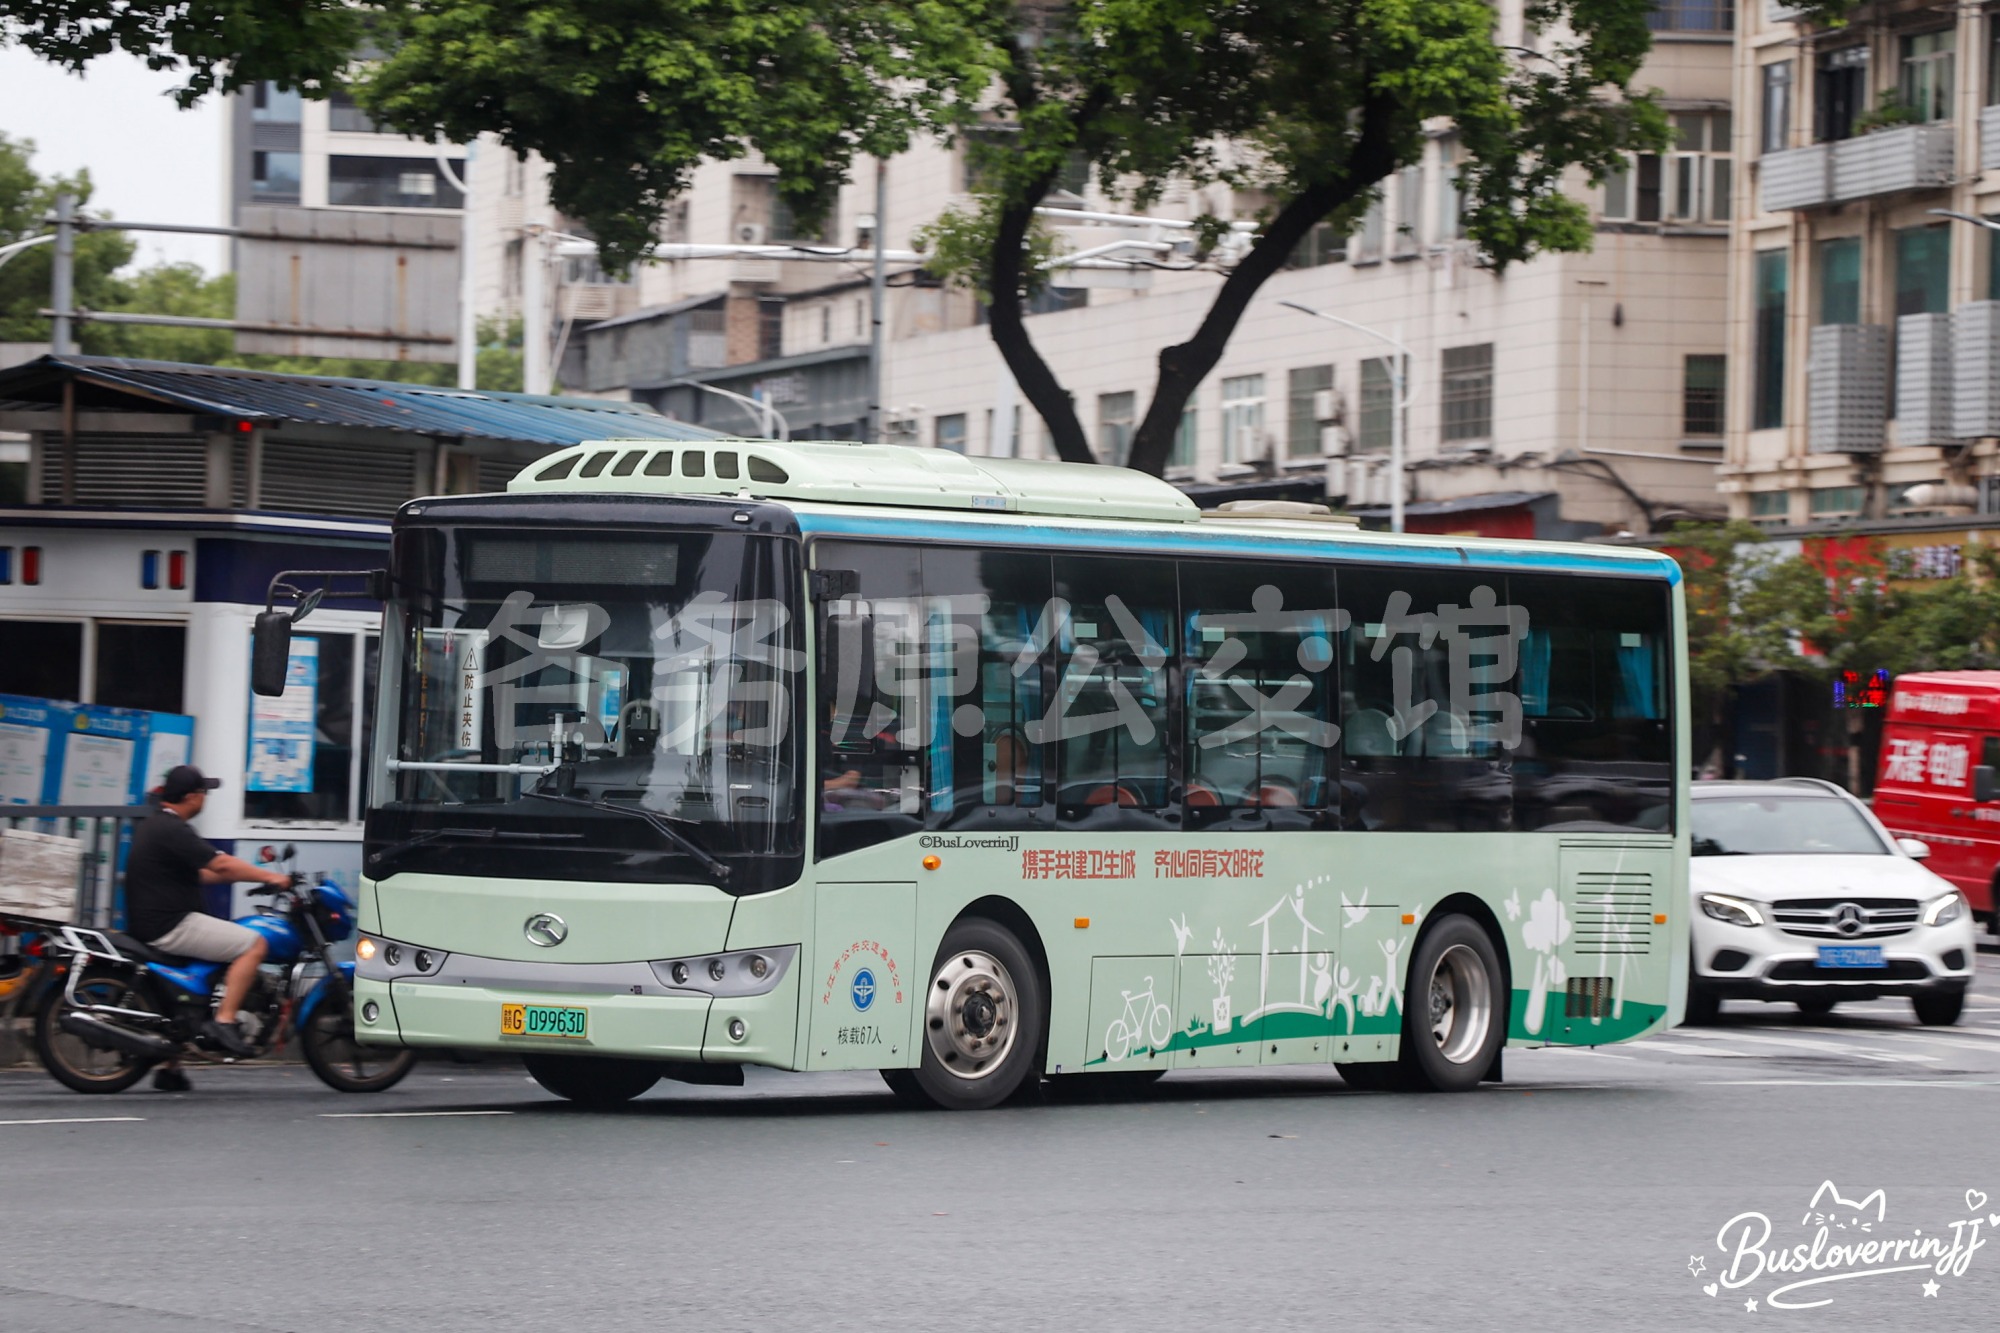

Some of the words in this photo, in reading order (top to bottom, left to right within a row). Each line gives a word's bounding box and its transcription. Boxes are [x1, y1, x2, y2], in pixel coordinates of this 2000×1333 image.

[461, 674, 475, 747] 防止夹伤
[1021, 849, 1136, 880] 携手共建卫生城
[1154, 849, 1264, 879] 齐心同育文明花
[838, 1025, 882, 1045] 核载67人
